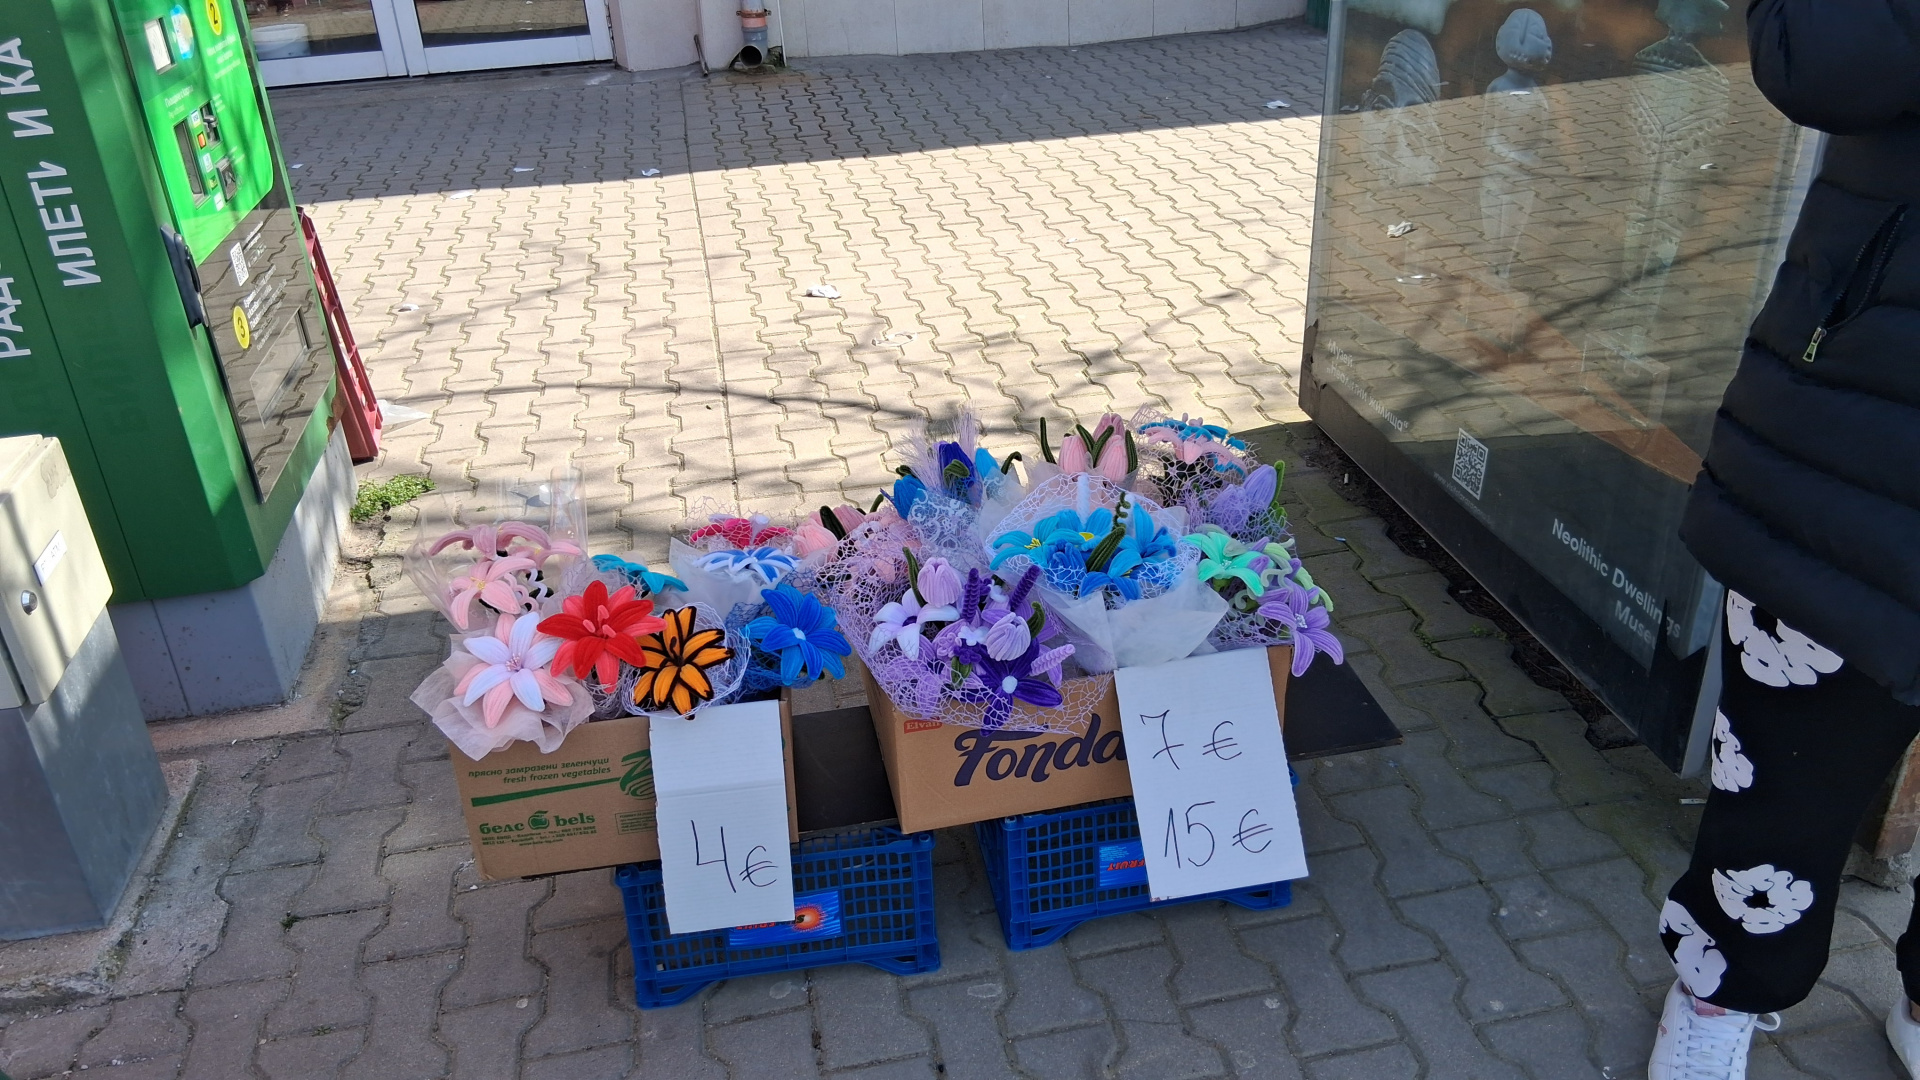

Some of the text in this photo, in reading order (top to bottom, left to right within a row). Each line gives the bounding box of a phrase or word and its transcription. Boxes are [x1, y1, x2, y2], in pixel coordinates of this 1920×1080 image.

[209, 2, 219, 25] 2
[7, 108, 54, 138] И
[237, 316, 246, 339] 3
[1551, 518, 1608, 577] Neolithic
[1139, 708, 1243, 771] 7 €
[468, 758, 610, 778] прясно замразени зеленчуци
[503, 766, 612, 784] fresh frozen vegetables
[479, 822, 525, 835] белс
[553, 812, 596, 827] bels
[1164, 800, 1274, 868] 15 €
